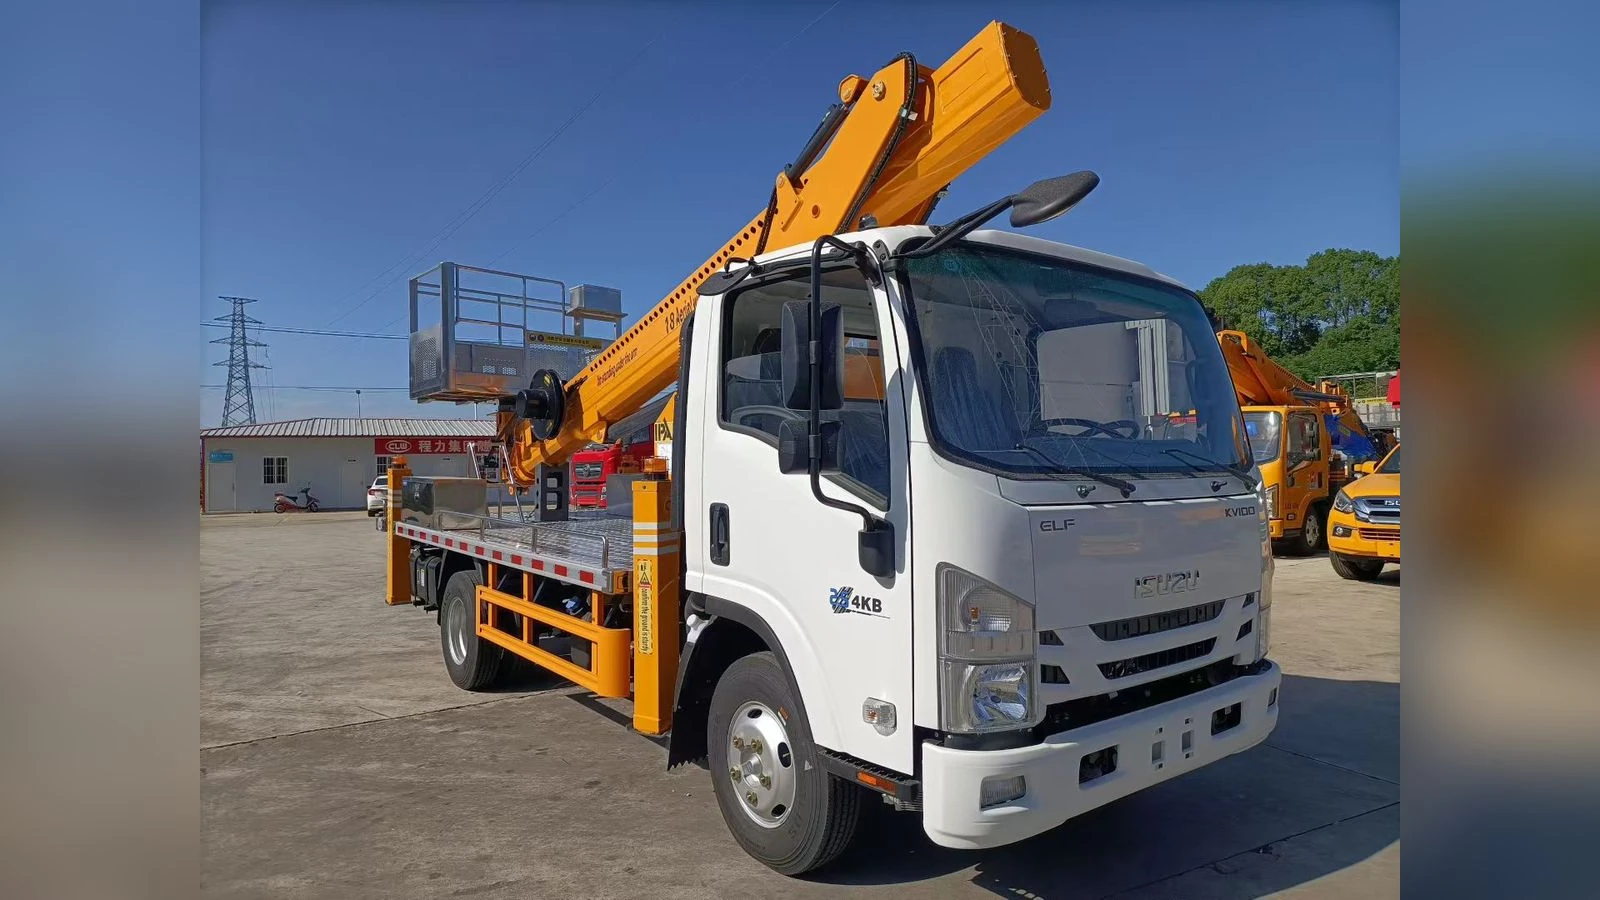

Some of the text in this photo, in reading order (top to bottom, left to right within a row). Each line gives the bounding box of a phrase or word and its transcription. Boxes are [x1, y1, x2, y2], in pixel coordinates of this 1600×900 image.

[665, 312, 675, 334] 18
[1040, 519, 1075, 531] ELF
[1135, 570, 1200, 600] ISUZU
[851, 595, 882, 613] 4KB
